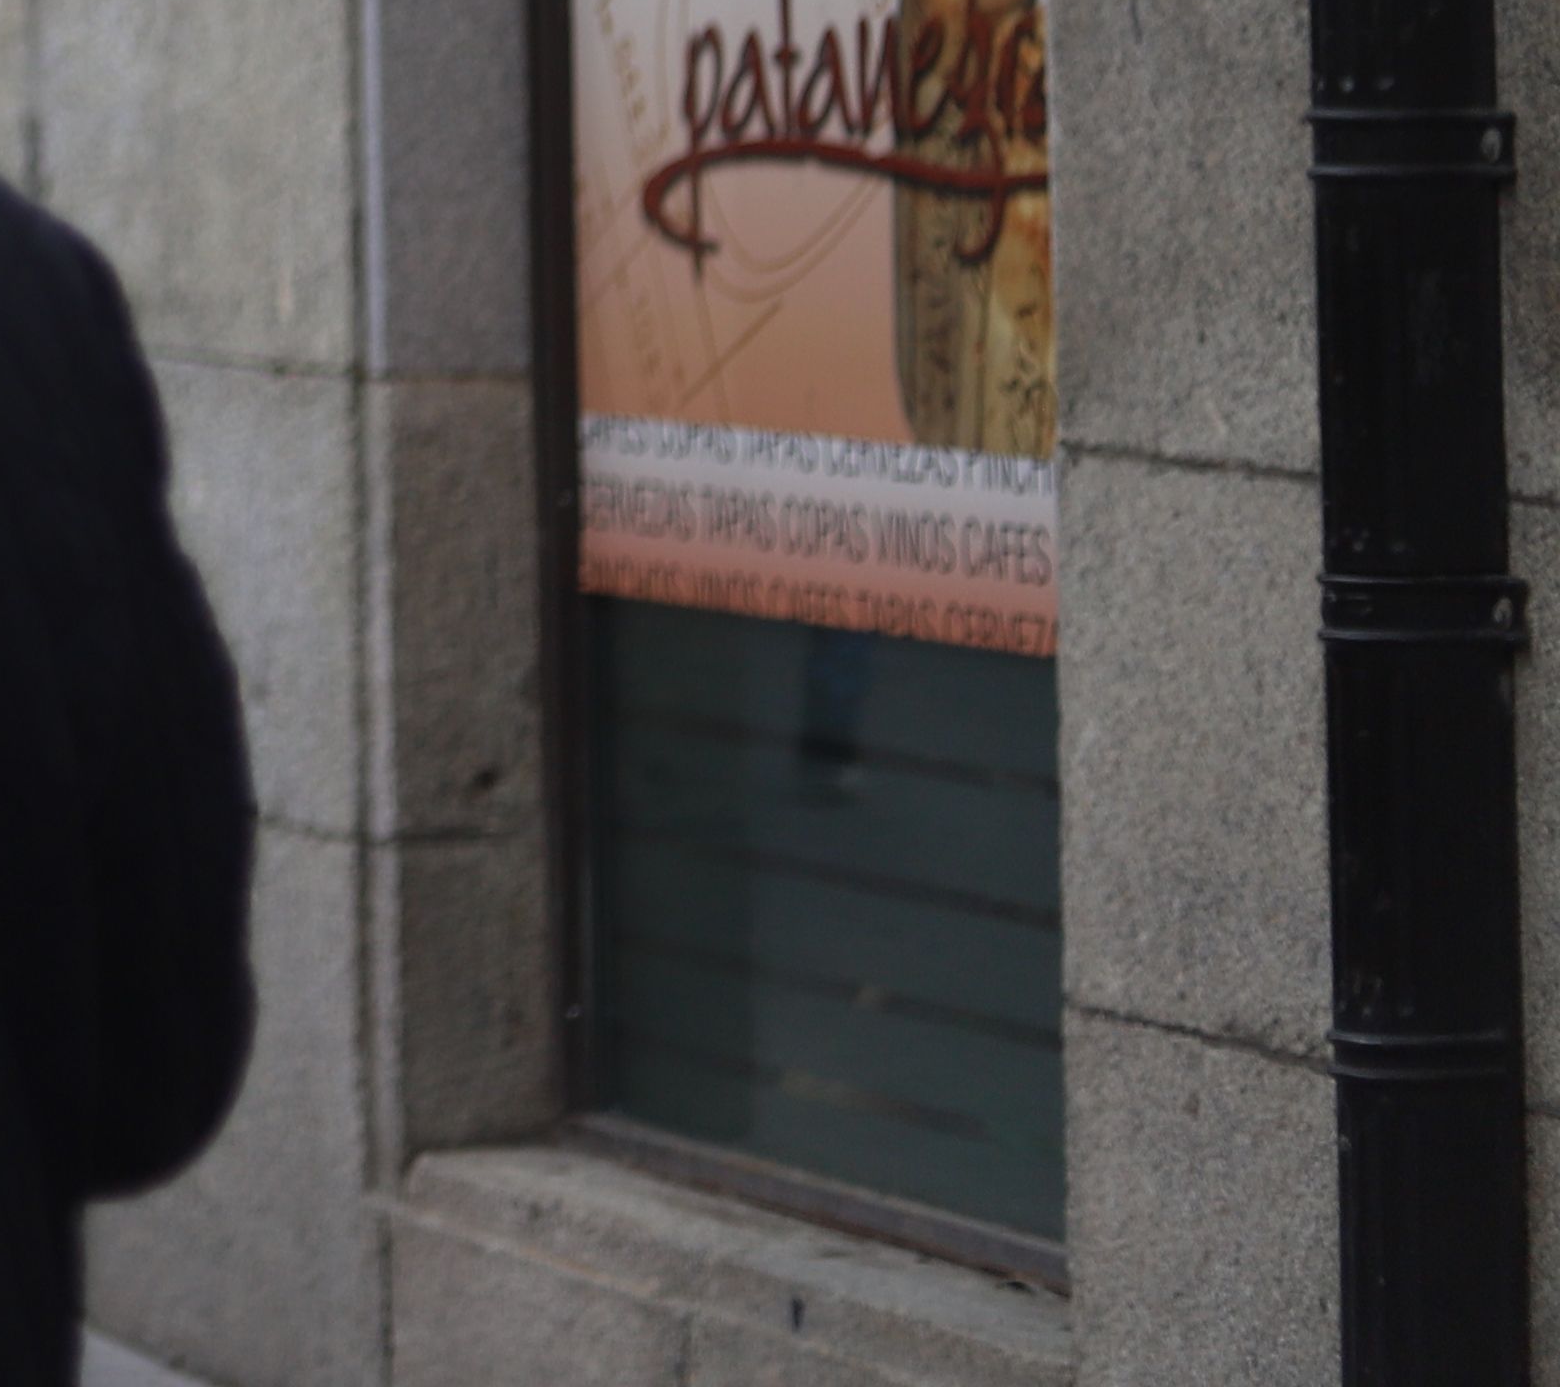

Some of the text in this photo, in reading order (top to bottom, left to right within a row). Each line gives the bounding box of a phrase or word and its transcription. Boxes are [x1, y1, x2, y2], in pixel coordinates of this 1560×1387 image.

[697, 486, 778, 554] TAPAS
[778, 495, 870, 565] COPAS
[871, 506, 958, 575] VINOS
[960, 517, 1053, 587] CAFES
